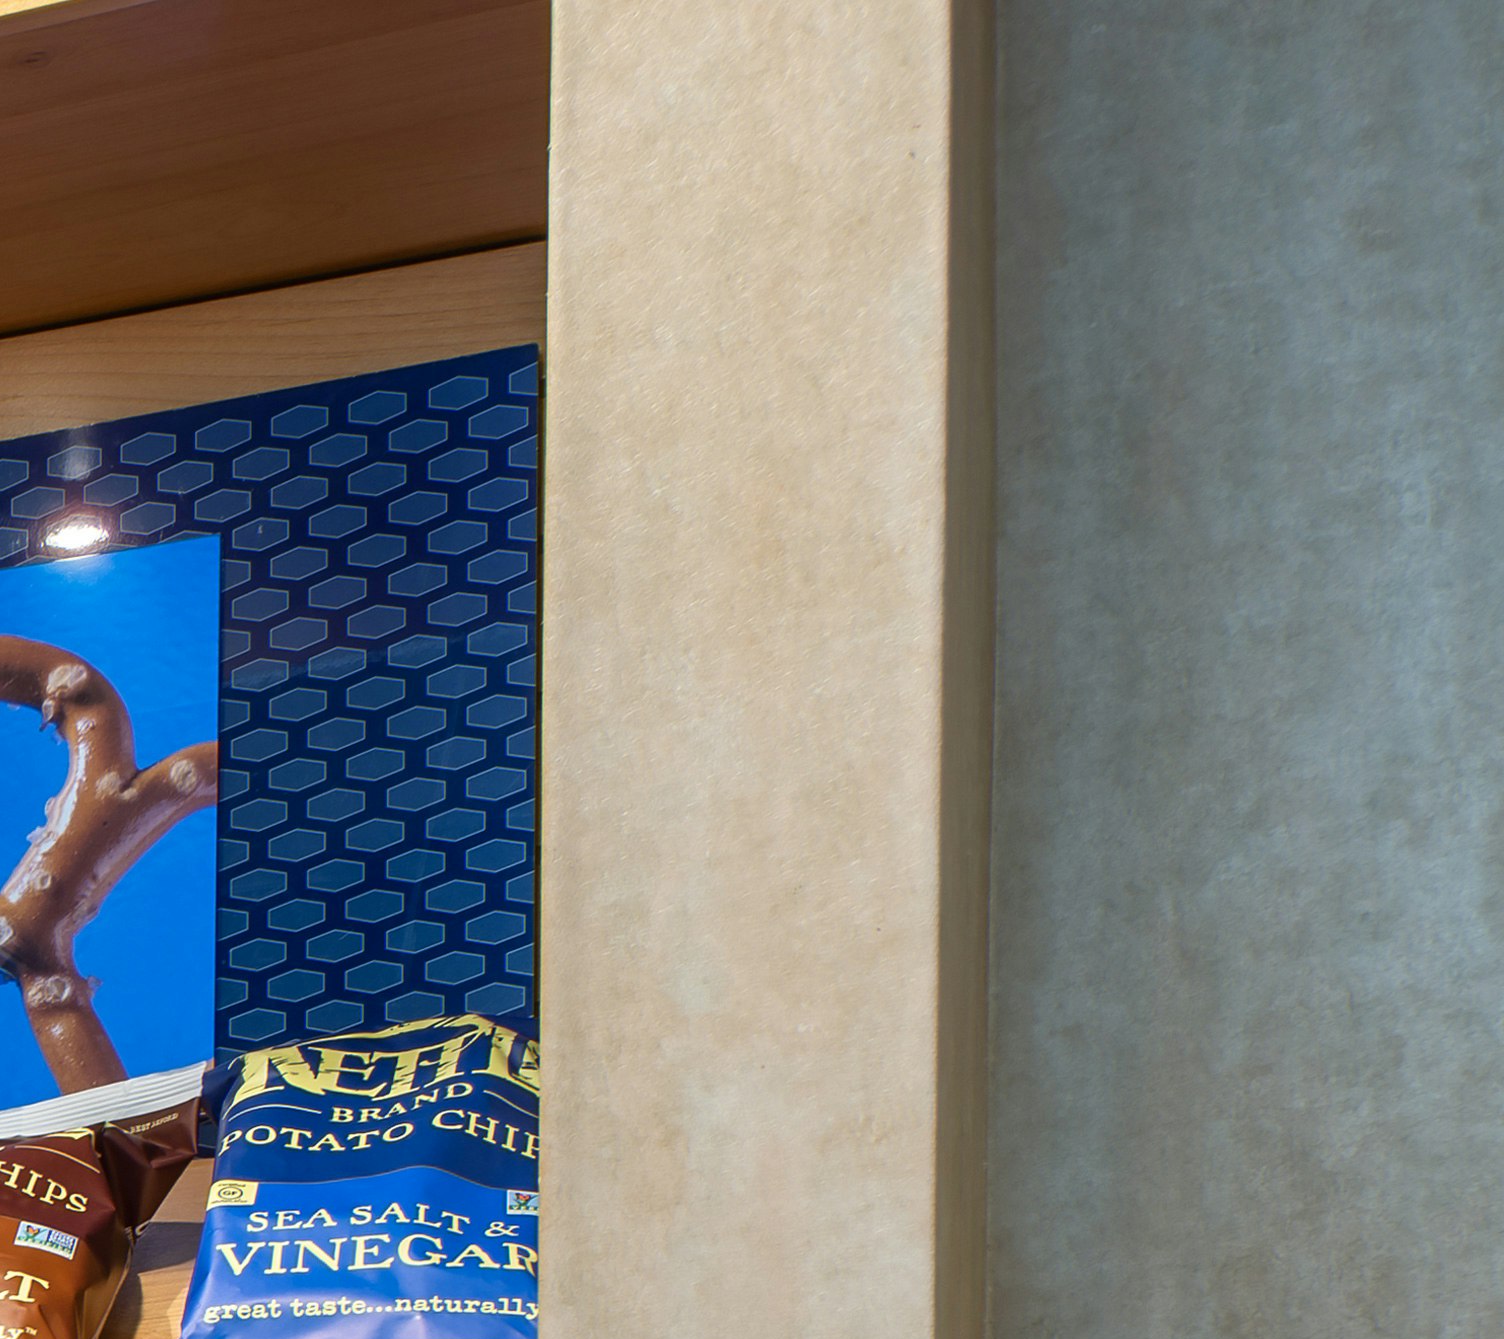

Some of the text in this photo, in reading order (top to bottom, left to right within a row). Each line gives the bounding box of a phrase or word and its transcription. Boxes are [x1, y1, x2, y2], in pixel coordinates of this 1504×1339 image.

[330, 1082, 475, 1124] BRAND
[219, 1122, 416, 1158] POTATO
[245, 1202, 471, 1236] SEA SALT
[203, 1301, 282, 1324] great
